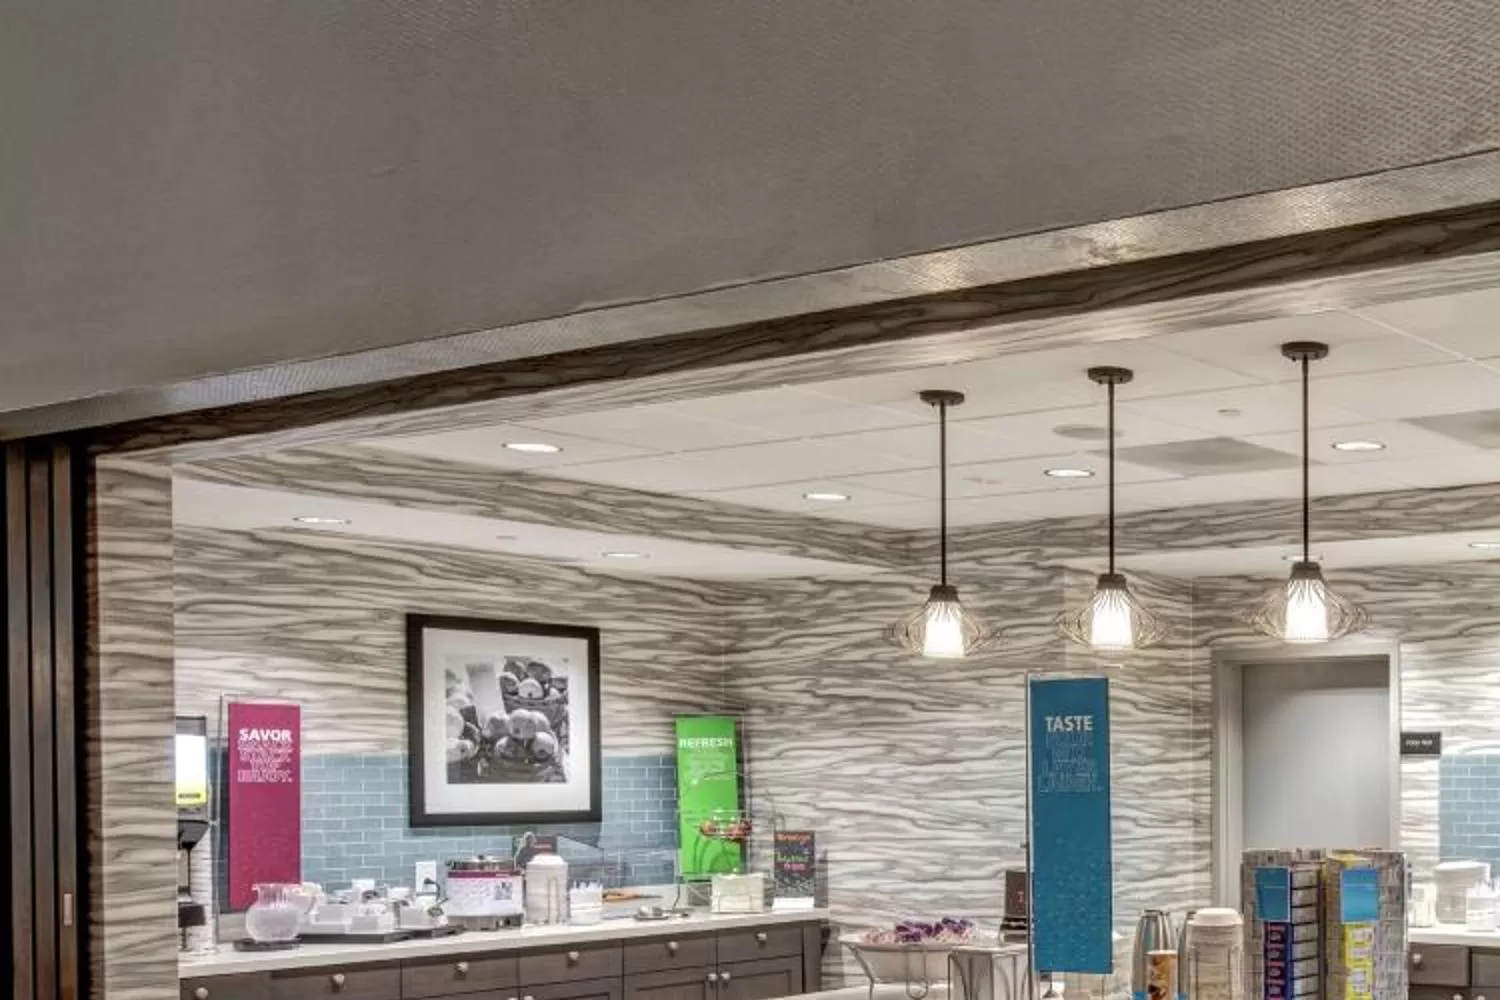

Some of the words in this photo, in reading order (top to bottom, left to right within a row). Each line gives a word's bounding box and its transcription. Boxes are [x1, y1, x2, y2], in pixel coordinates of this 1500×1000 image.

[1044, 715, 1093, 732] TASTE
[239, 728, 292, 741] SAVOR
[679, 737, 733, 749] REFRESH
